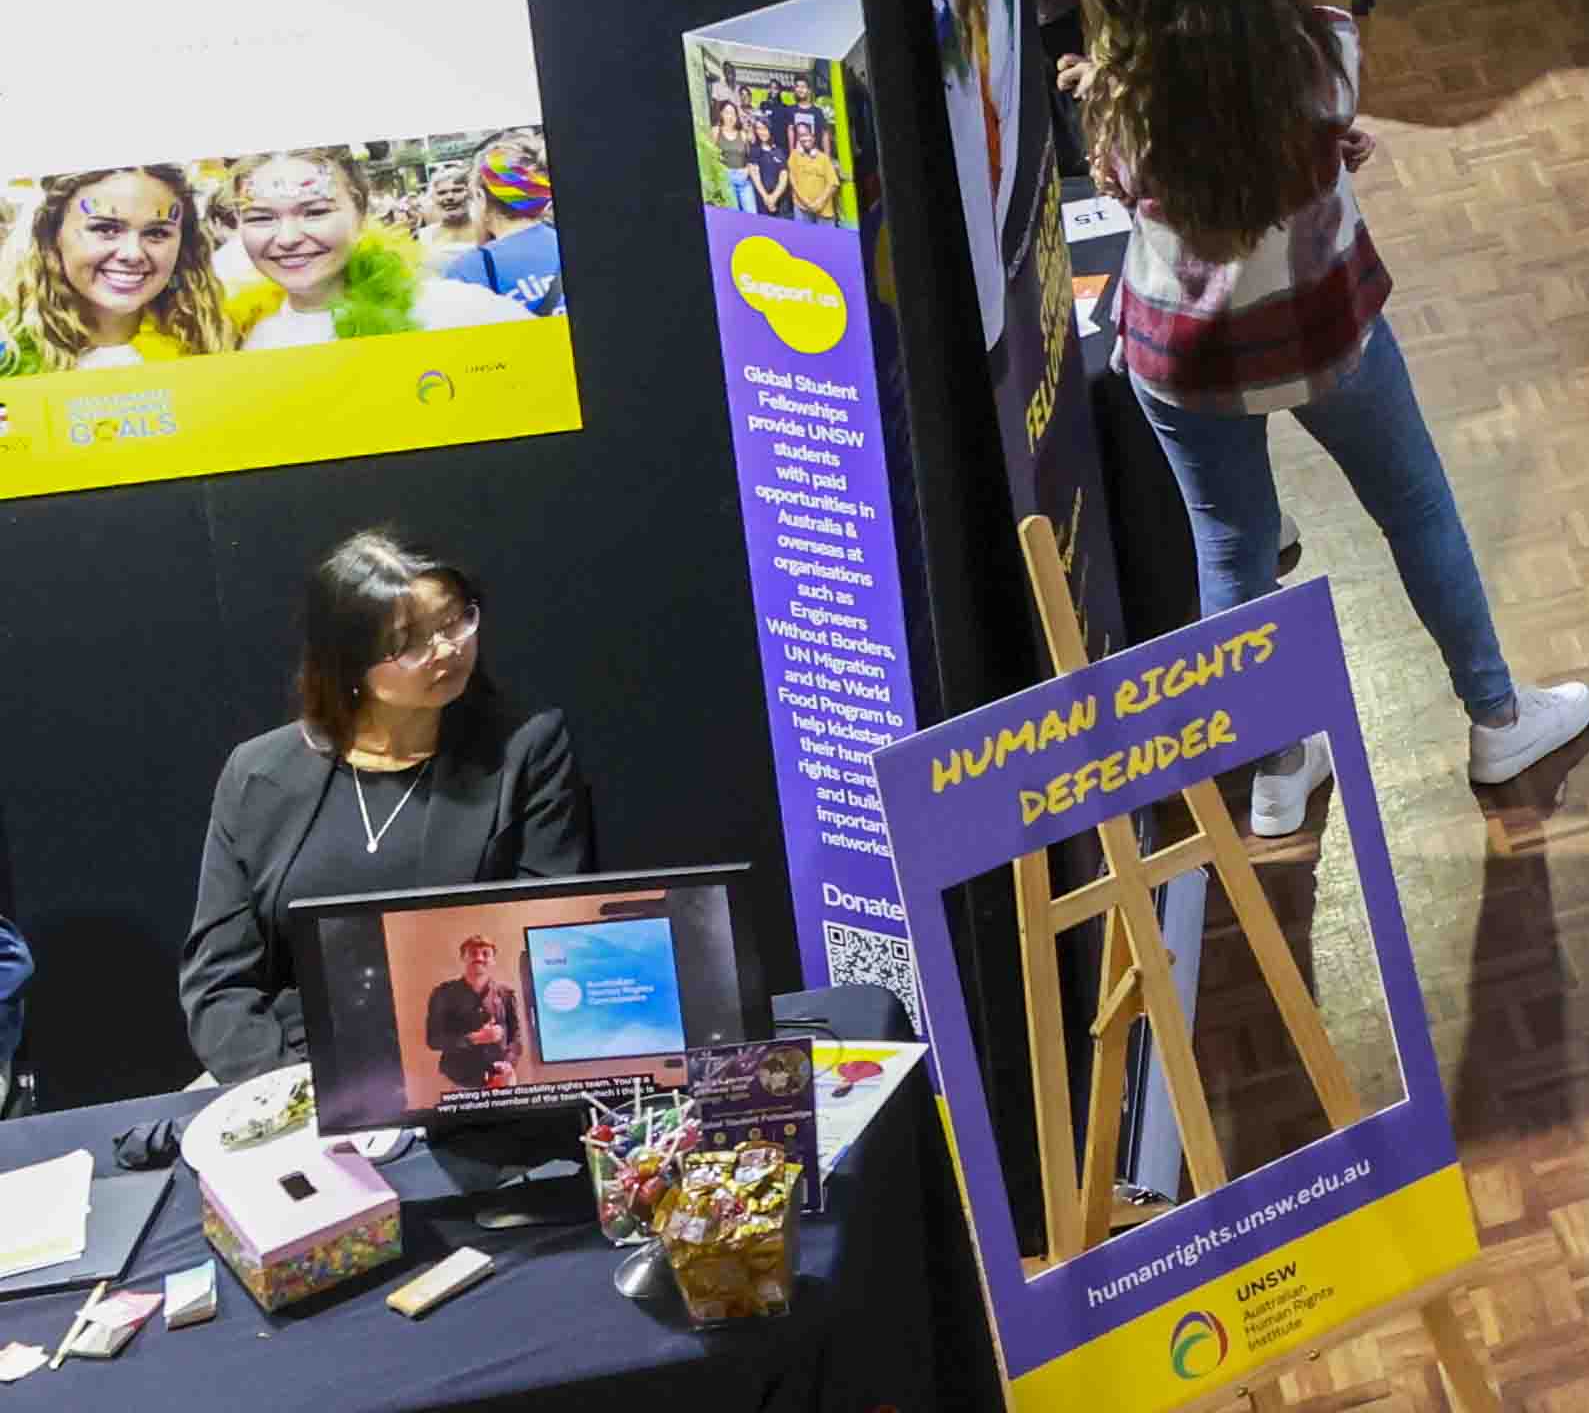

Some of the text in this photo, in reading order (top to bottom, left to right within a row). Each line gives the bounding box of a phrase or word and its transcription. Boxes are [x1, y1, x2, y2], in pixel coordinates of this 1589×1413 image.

[739, 273, 840, 308] Support us
[744, 365, 859, 401] Global Student
[758, 391, 849, 424] Fellowships
[70, 413, 177, 445] GOALS
[748, 415, 865, 448] provide UNSW
[774, 441, 841, 468] students
[776, 465, 847, 492] with paid
[755, 484, 876, 519] opportunities in
[778, 508, 858, 539] Australia &
[778, 534, 865, 563] overseas at
[774, 554, 873, 588] organisations
[797, 581, 855, 607] such as
[790, 601, 869, 632] Engineers
[766, 616, 897, 662] Without Borders,
[783, 644, 885, 681] UN Migration
[783, 668, 891, 703] and the World
[778, 686, 903, 729] Food Program to
[930, 621, 1279, 794] HUMAN RIGHTS
[792, 710, 894, 747] help kickstart
[800, 734, 836, 760] their
[798, 758, 841, 785] rights
[1019, 708, 1238, 826] DEFENDER
[816, 786, 846, 806] and
[815, 806, 889, 836] importan
[822, 883, 905, 922] Donate
[1087, 1158, 1372, 1308] humanrights.unsw.edu.au
[1236, 1261, 1298, 1303] UNSW
[1242, 1282, 1308, 1323] Australian
[1244, 1284, 1335, 1336] Human Rights
[1247, 1317, 1304, 1352] Institute
